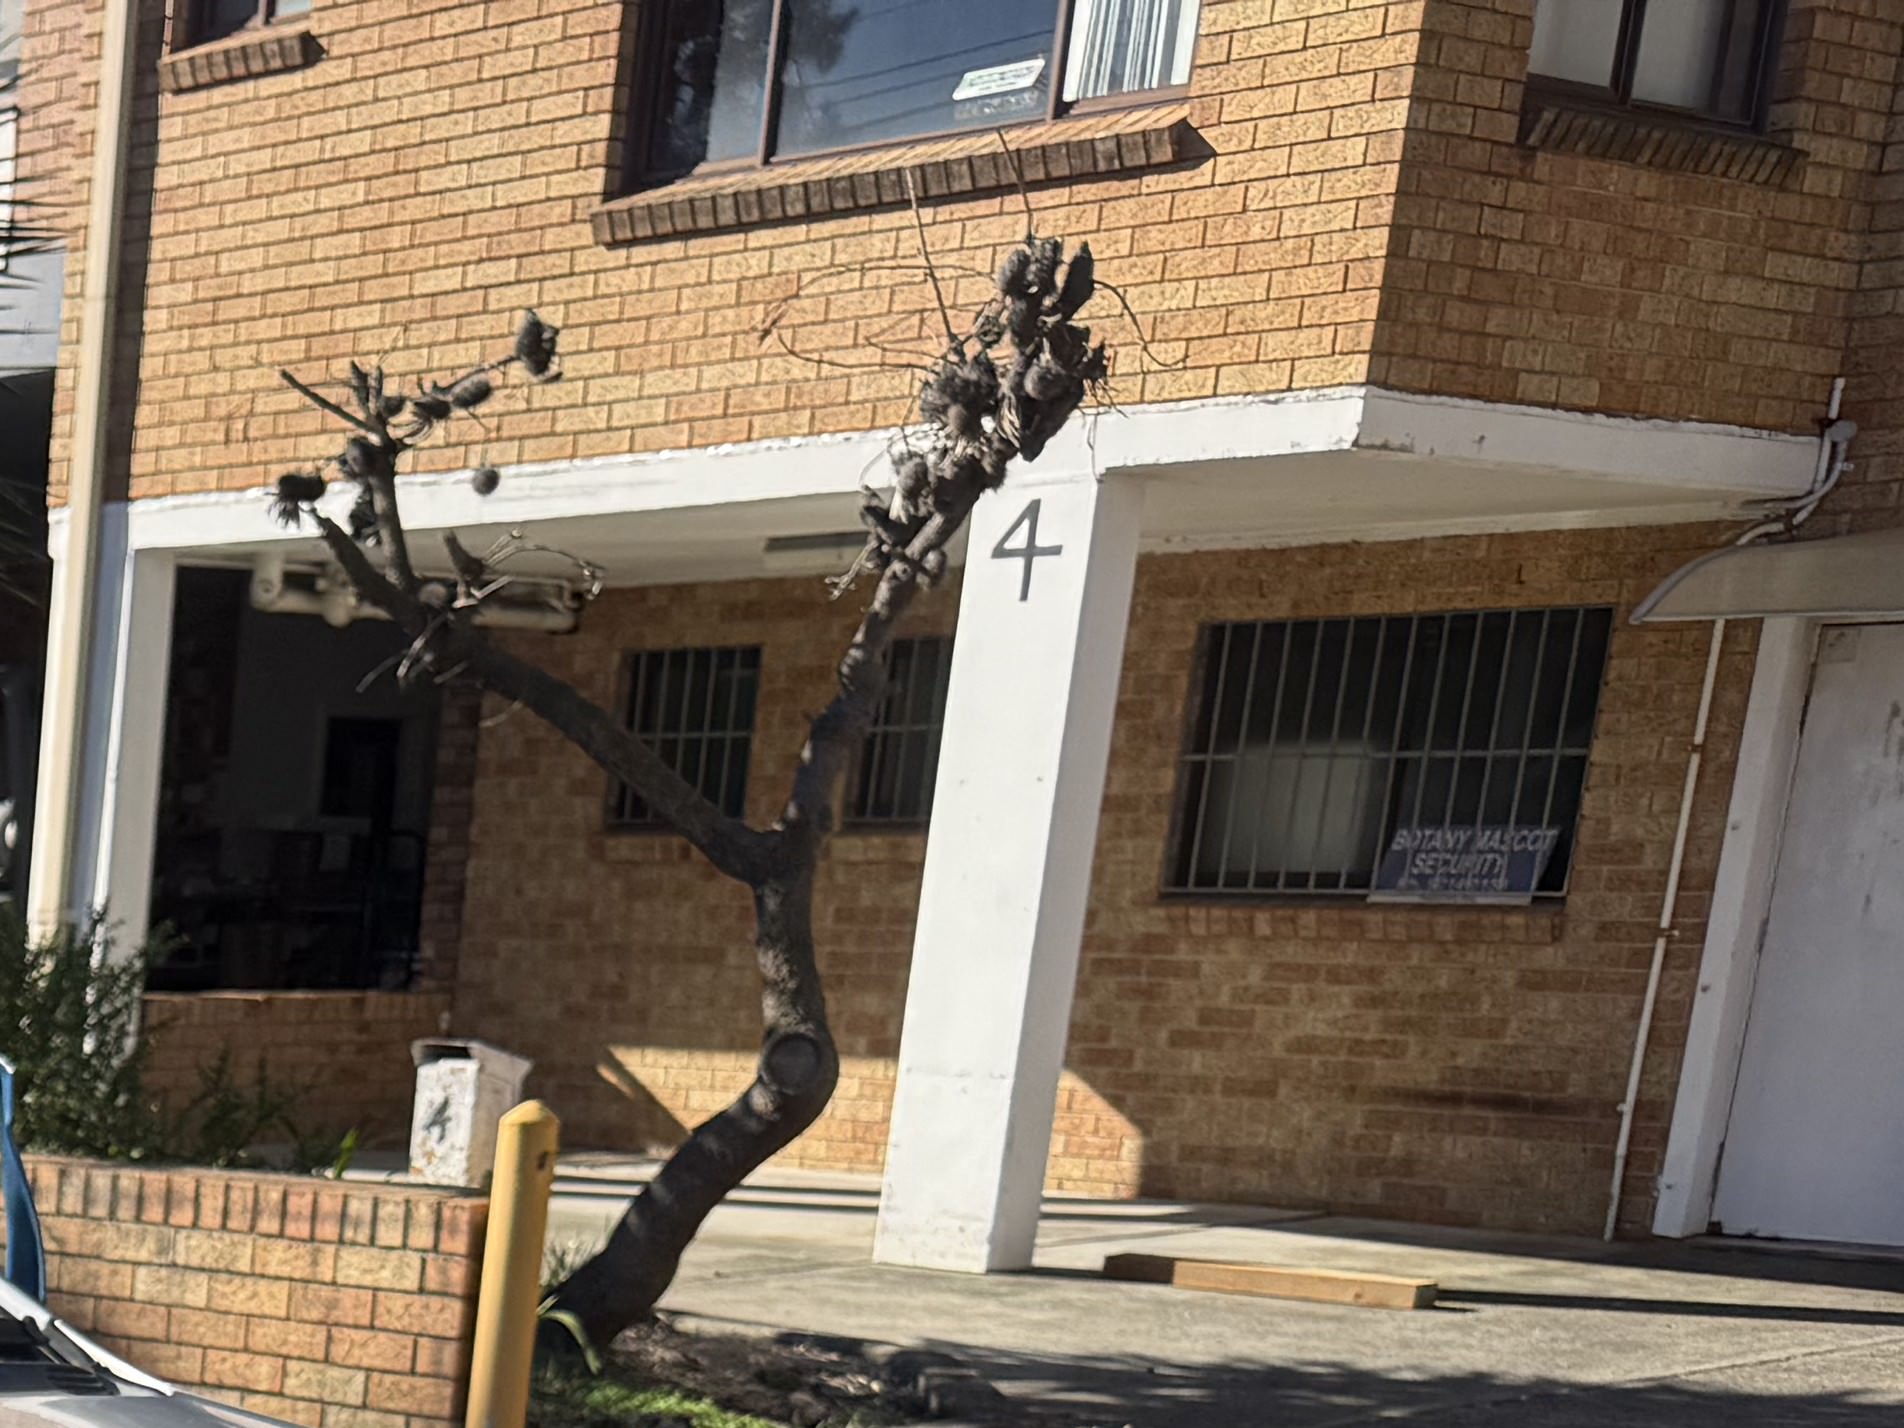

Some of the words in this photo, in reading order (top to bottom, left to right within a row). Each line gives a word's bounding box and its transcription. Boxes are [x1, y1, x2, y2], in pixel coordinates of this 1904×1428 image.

[991, 497, 1063, 603] 4
[1391, 828, 1472, 852] BOTANY
[423, 1096, 452, 1144] 4
